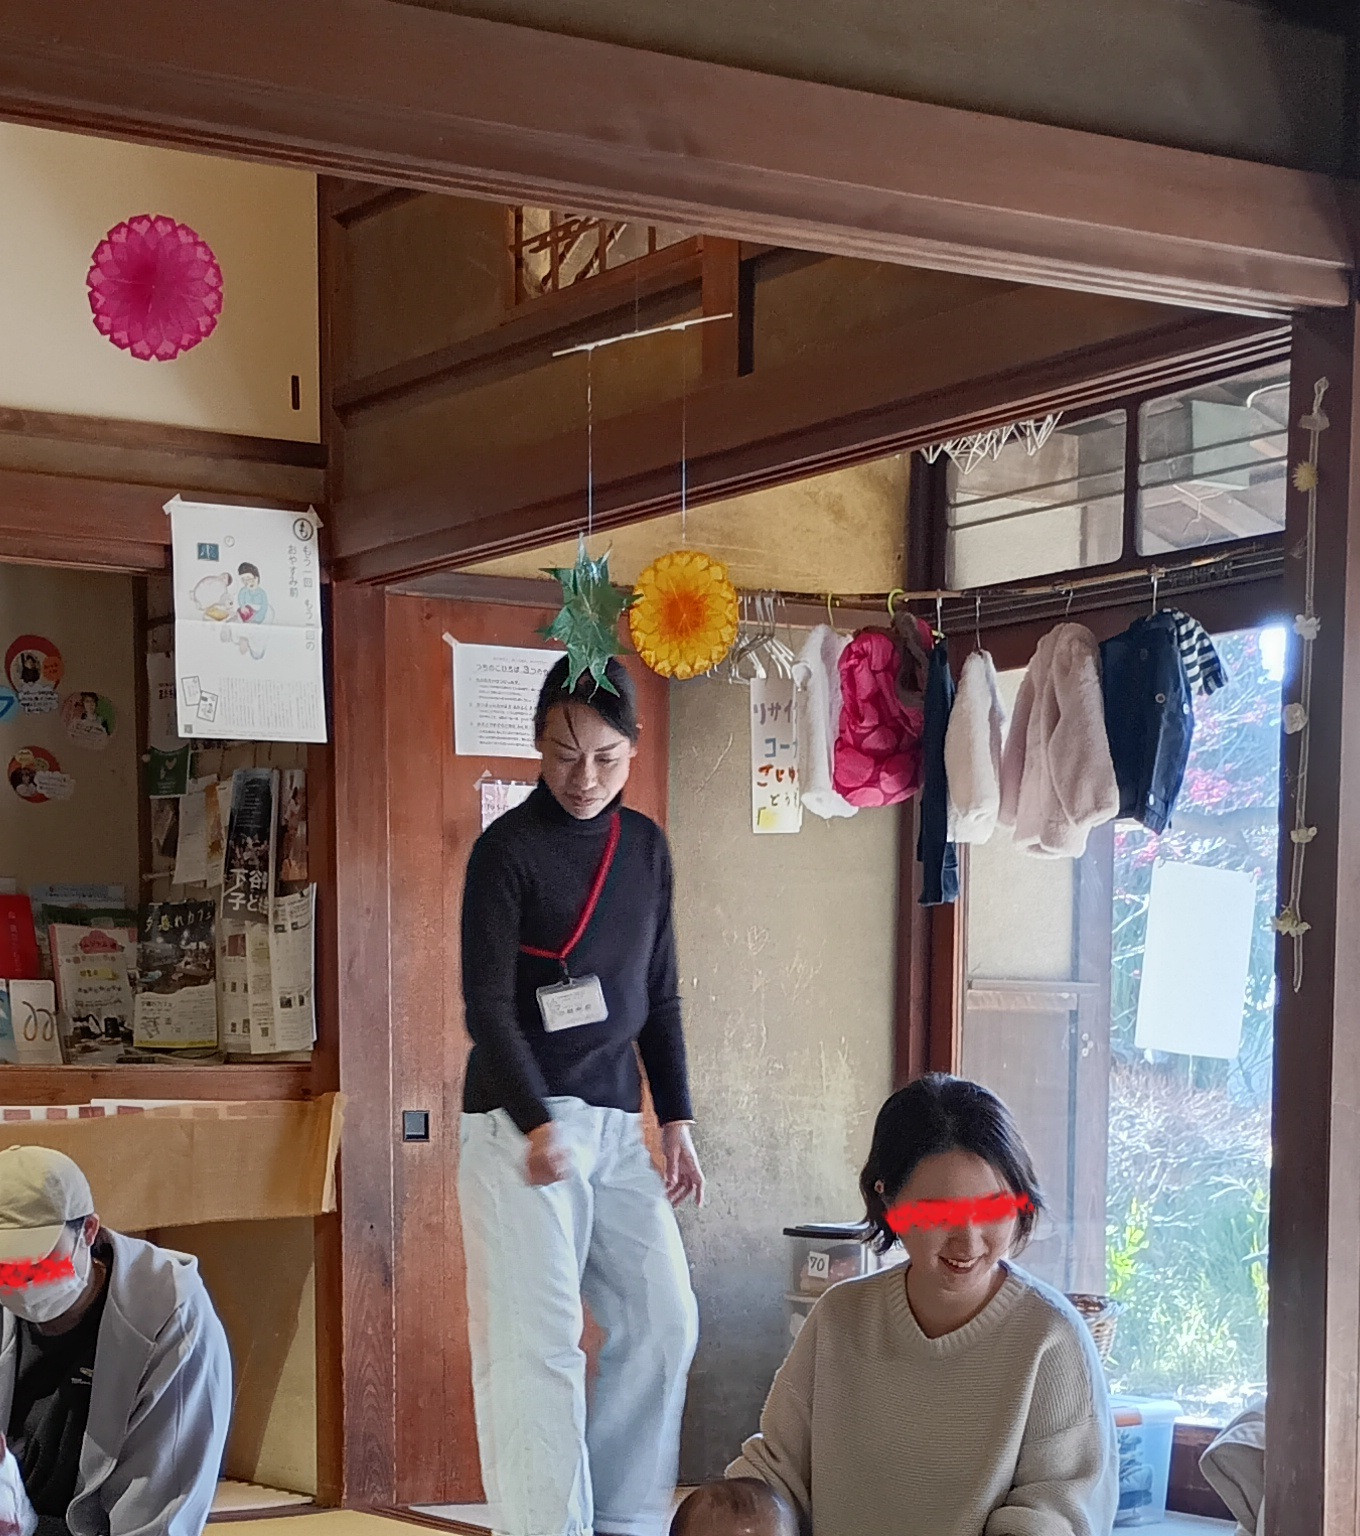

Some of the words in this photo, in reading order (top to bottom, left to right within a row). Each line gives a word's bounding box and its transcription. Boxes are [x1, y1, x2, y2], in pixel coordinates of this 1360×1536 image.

[753, 701, 798, 725] リサイ
[810, 1256, 825, 1272] 70
